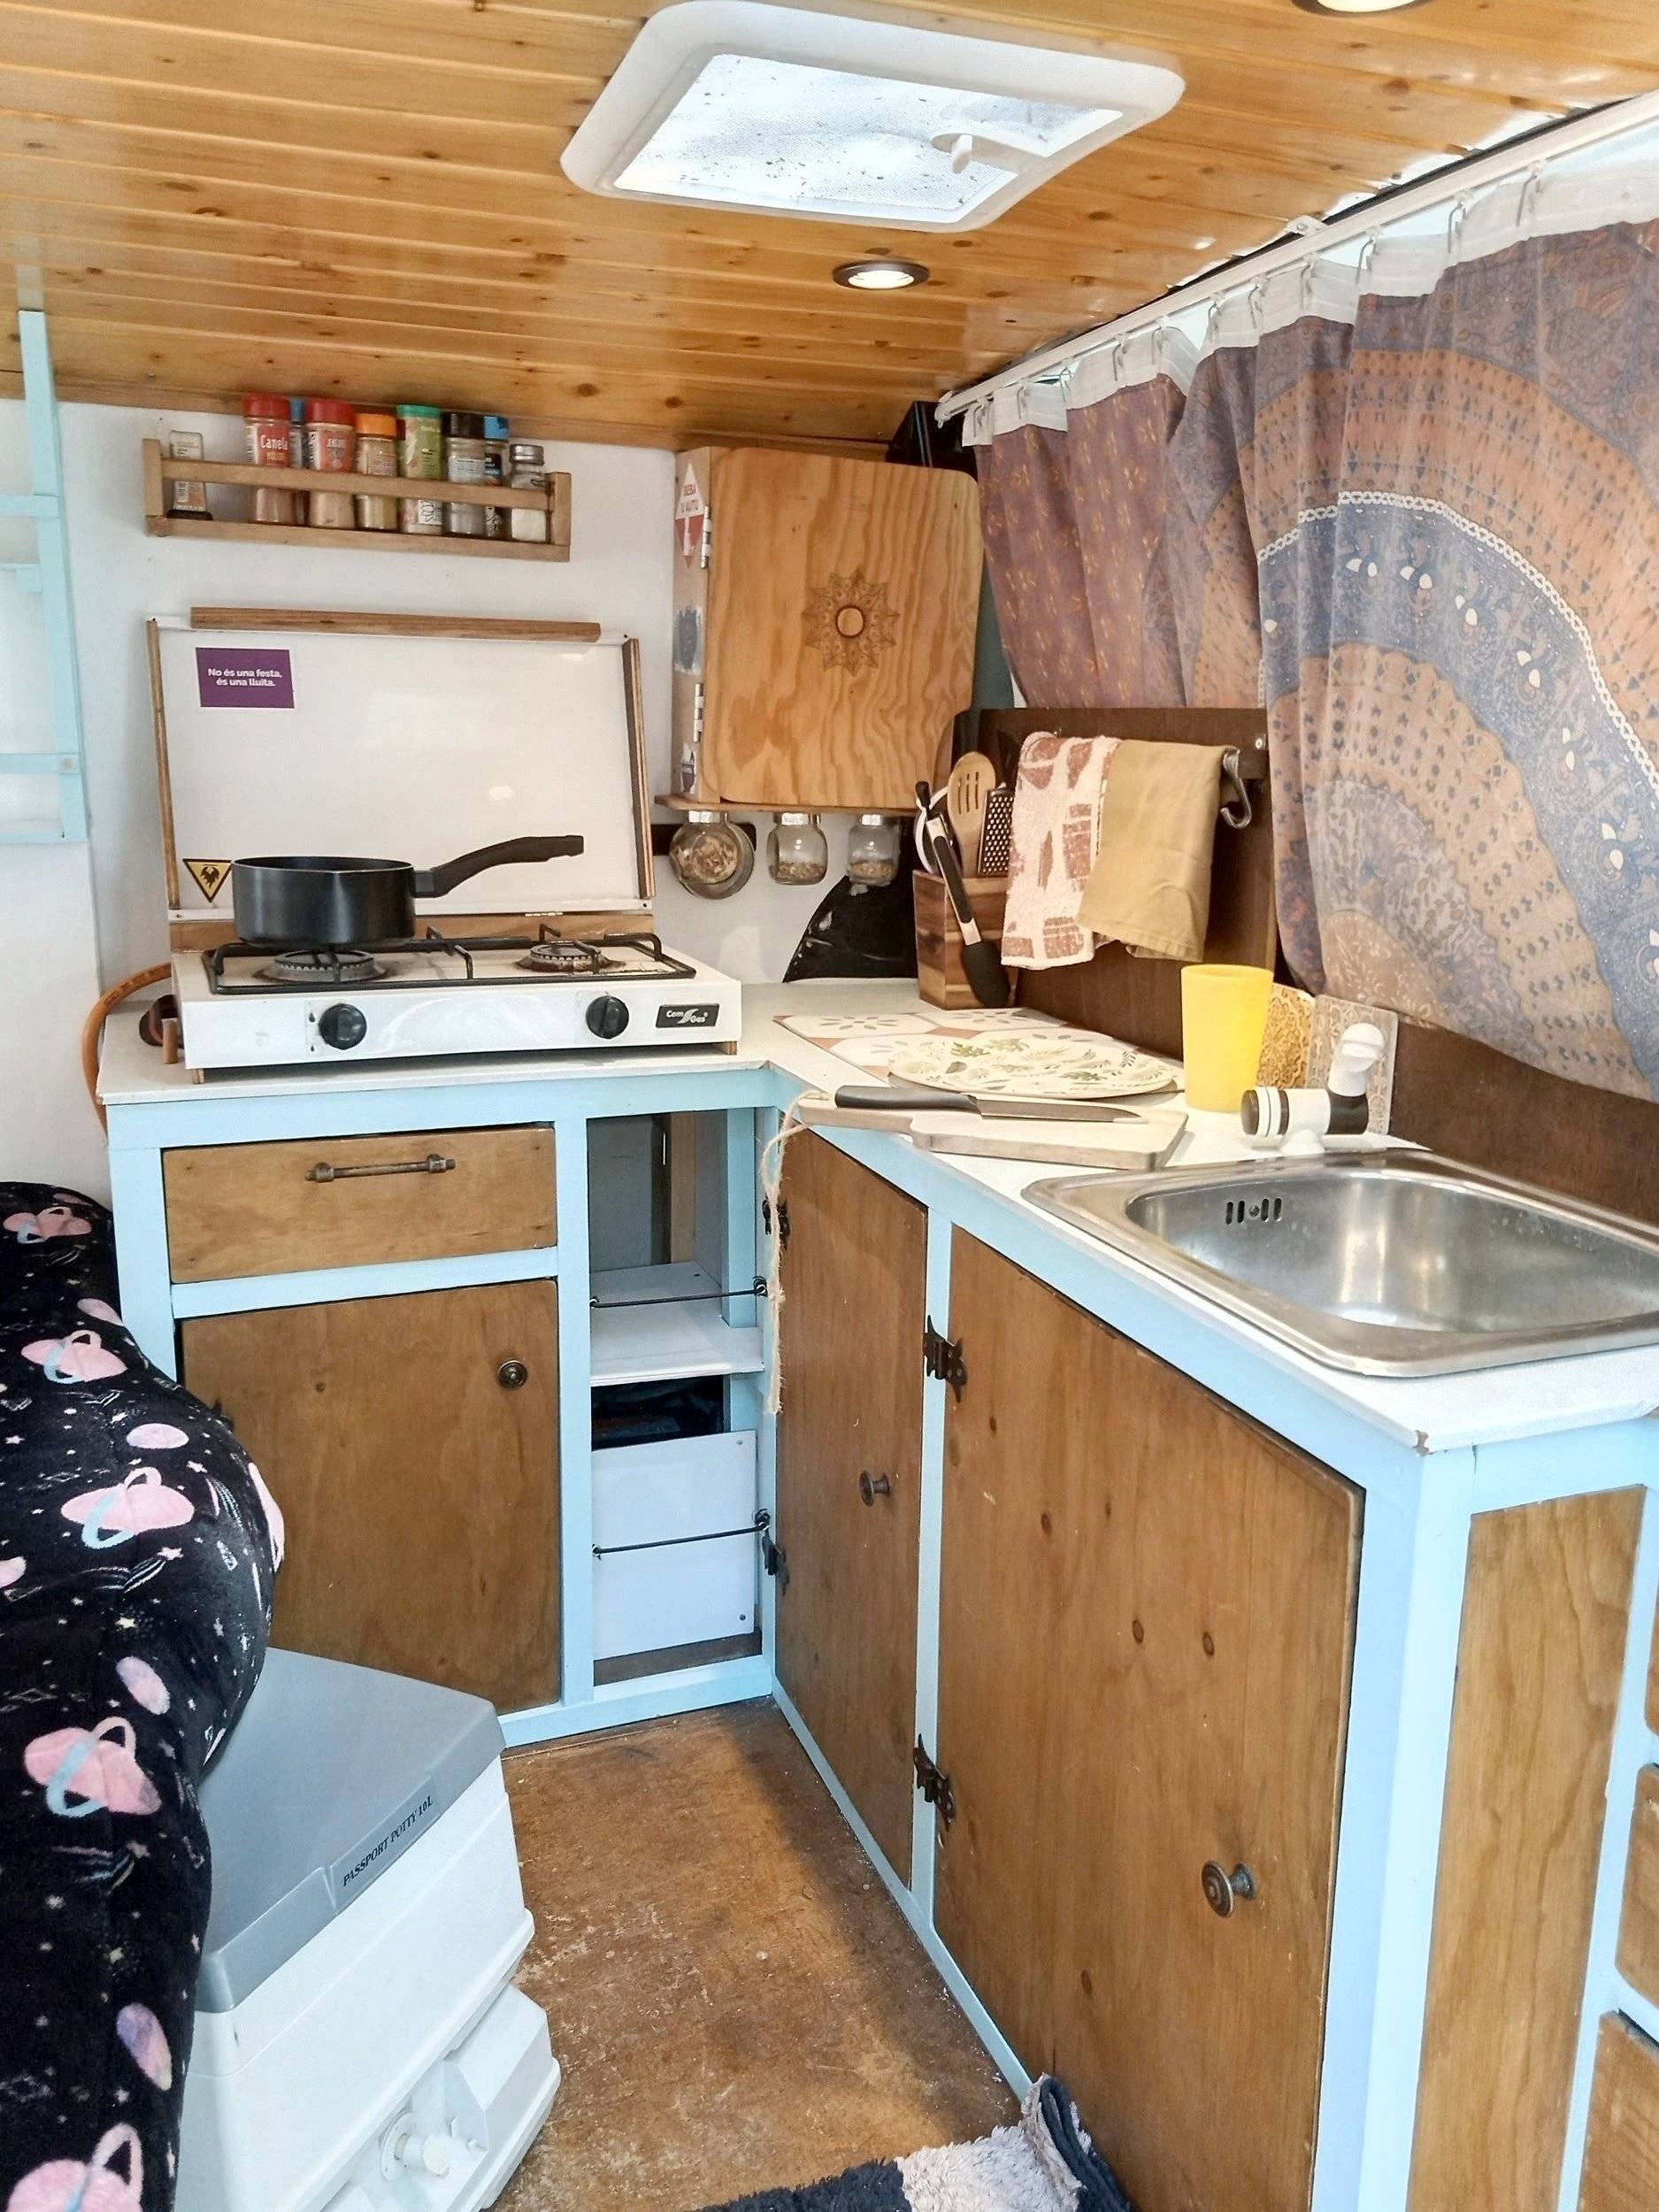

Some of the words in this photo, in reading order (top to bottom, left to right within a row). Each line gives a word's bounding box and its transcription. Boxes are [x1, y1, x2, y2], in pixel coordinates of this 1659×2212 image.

[260, 434, 288, 450] Canela
[208, 668, 222, 677] No
[223, 668, 234, 677] és
[256, 669, 282, 679] festa,
[249, 678, 276, 687] lluita.
[342, 1837, 389, 1886] PASSPORT
[390, 1811, 417, 1842] POTTY
[418, 1795, 434, 1816] 10L
